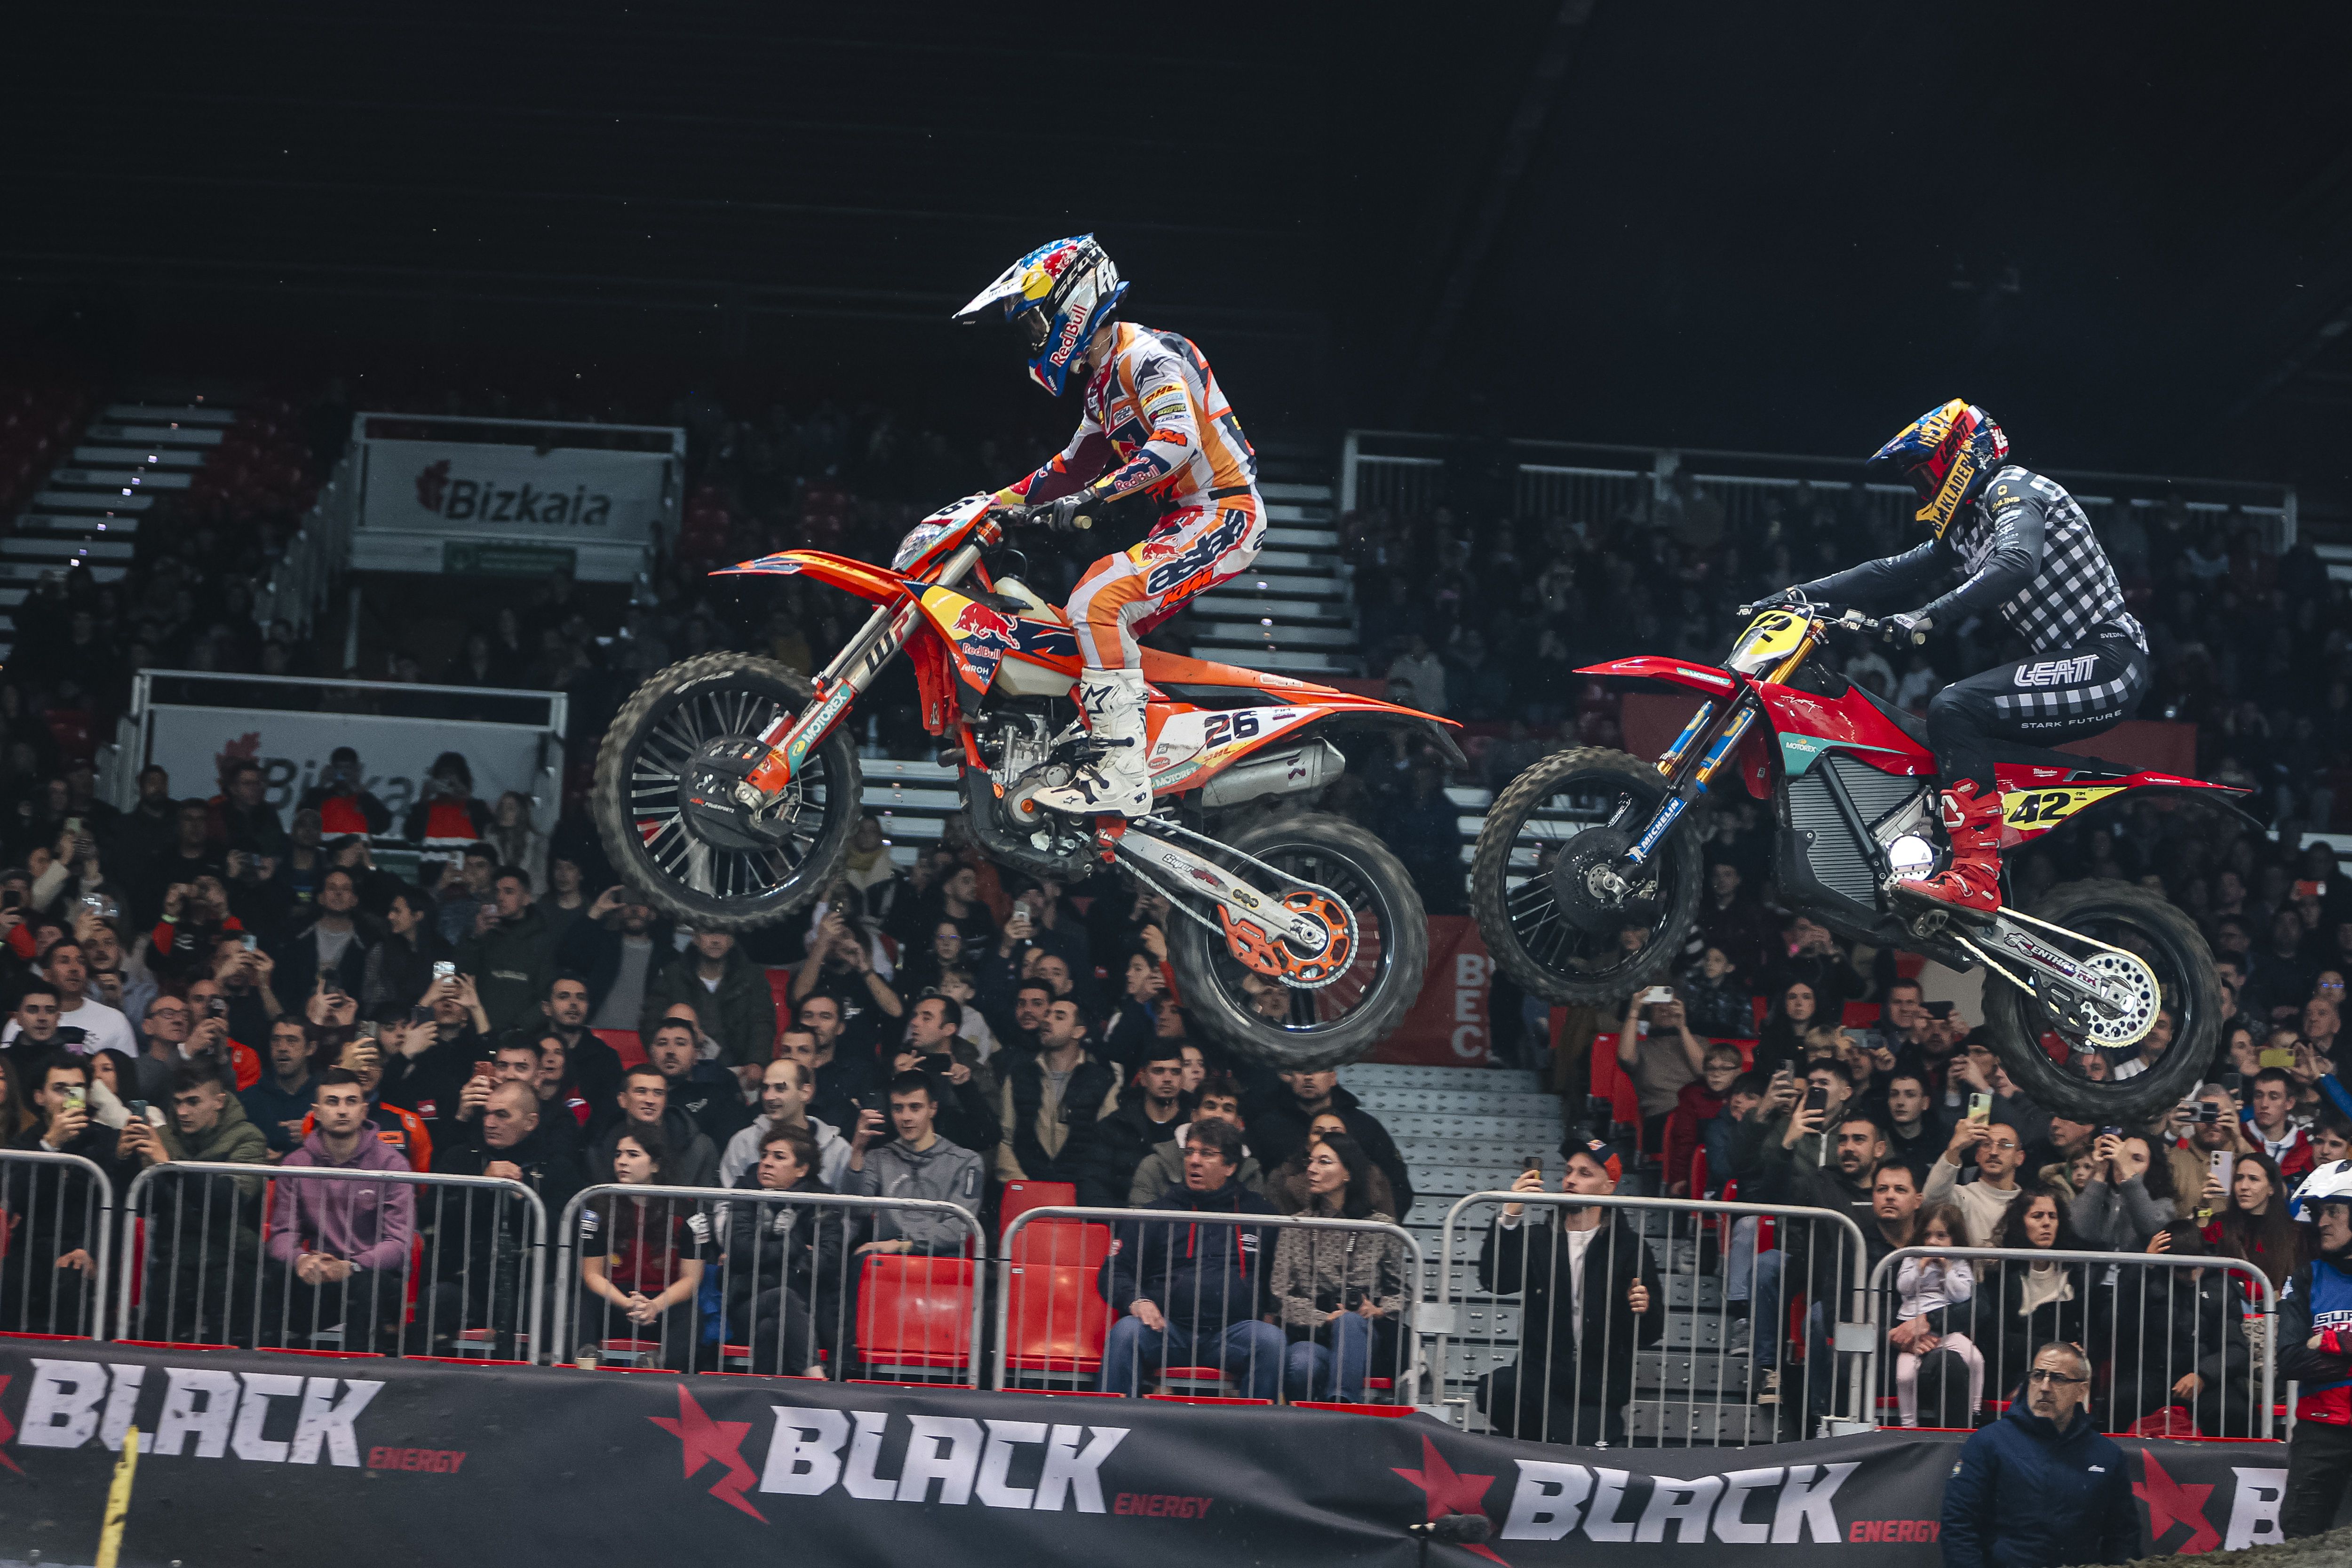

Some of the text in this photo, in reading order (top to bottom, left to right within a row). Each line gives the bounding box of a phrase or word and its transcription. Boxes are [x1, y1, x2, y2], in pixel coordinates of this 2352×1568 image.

[445, 478, 610, 525] Bizkaia
[962, 642, 1001, 660] Red Bull
[2014, 654, 2100, 687] LEATT
[802, 691, 847, 743] MOTOREX
[1204, 710, 1259, 750] 26
[2068, 709, 2122, 725] FUTURE
[1786, 742, 1817, 753] MOTOREX
[1641, 799, 1679, 849] MICHELIN
[2008, 792, 2071, 824] 42
[17, 1358, 467, 1474] BLACK ENERGY
[758, 1405, 1213, 1519] BLACK ENERGY
[1500, 1458, 1941, 1545] BLACK ENERGY
